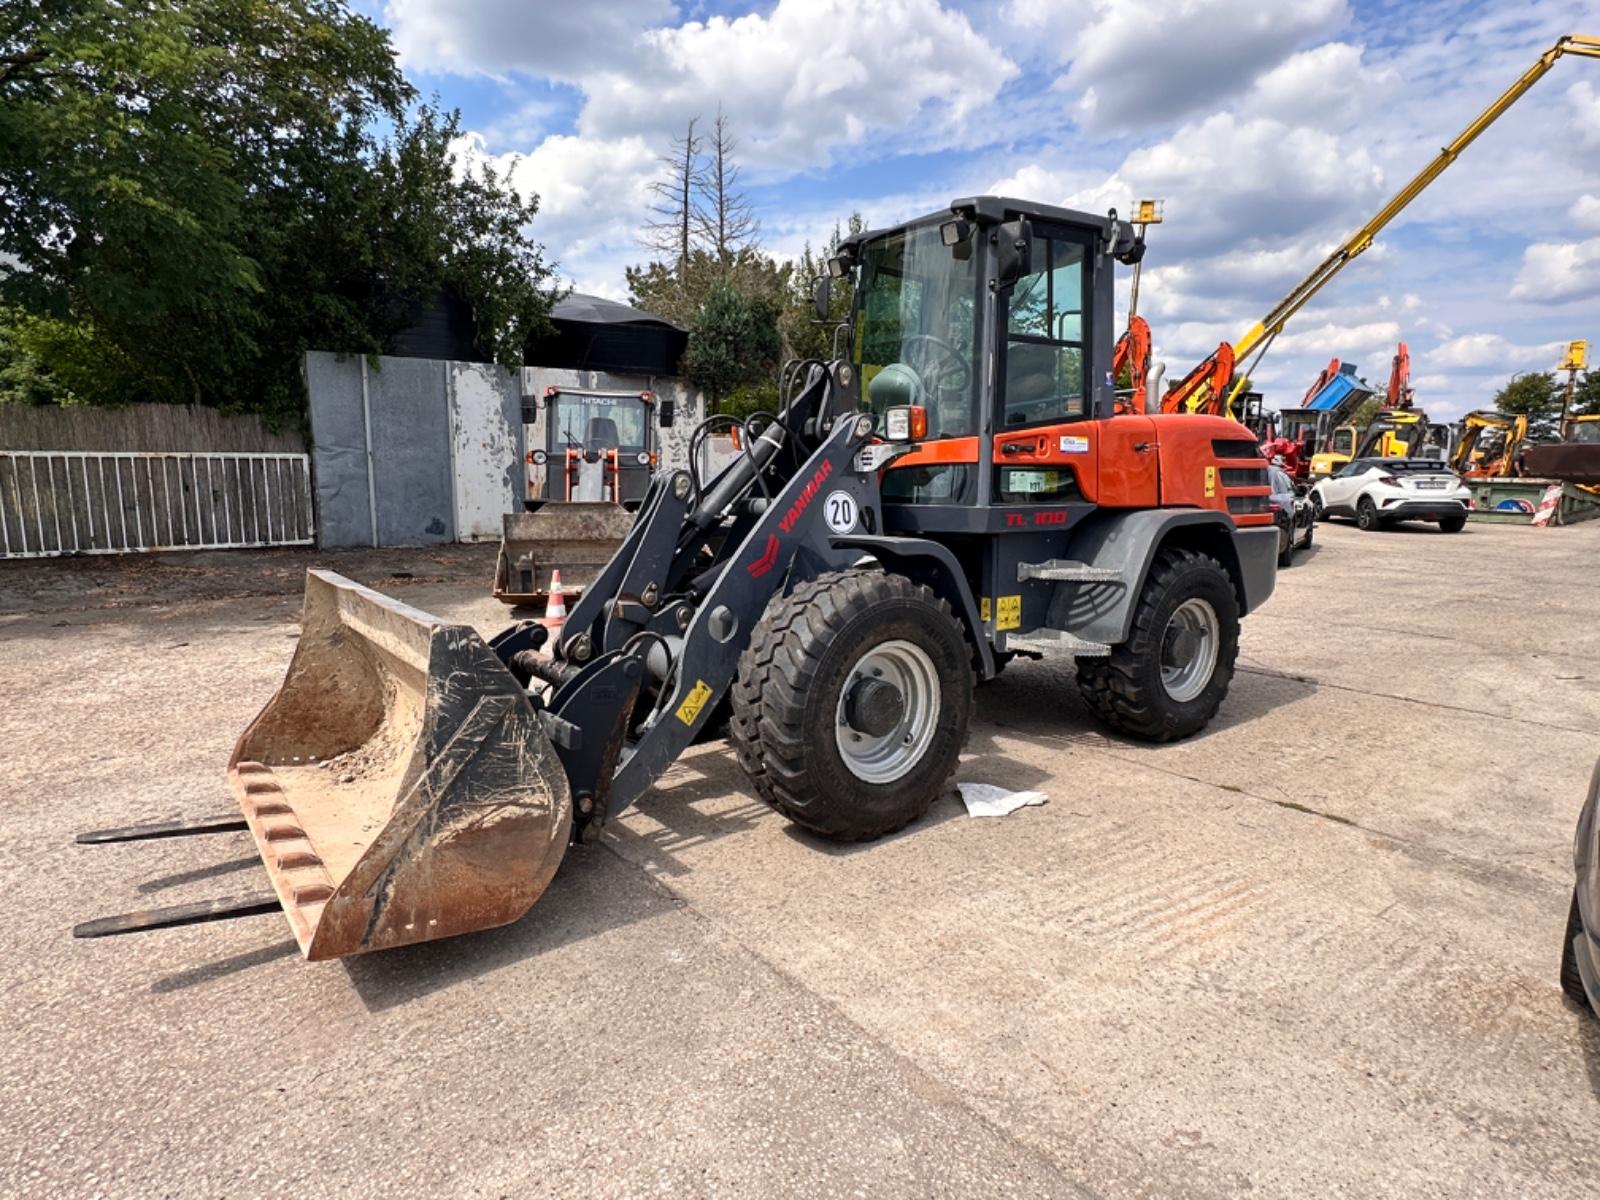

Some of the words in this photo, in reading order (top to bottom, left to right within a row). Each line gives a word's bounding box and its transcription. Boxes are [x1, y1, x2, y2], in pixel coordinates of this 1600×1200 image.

[582, 397, 617, 406] HITACHI
[777, 458, 833, 534] YANMAR
[830, 499, 852, 526] 20
[1006, 513, 1025, 527] TL
[1034, 511, 1067, 526] 100
